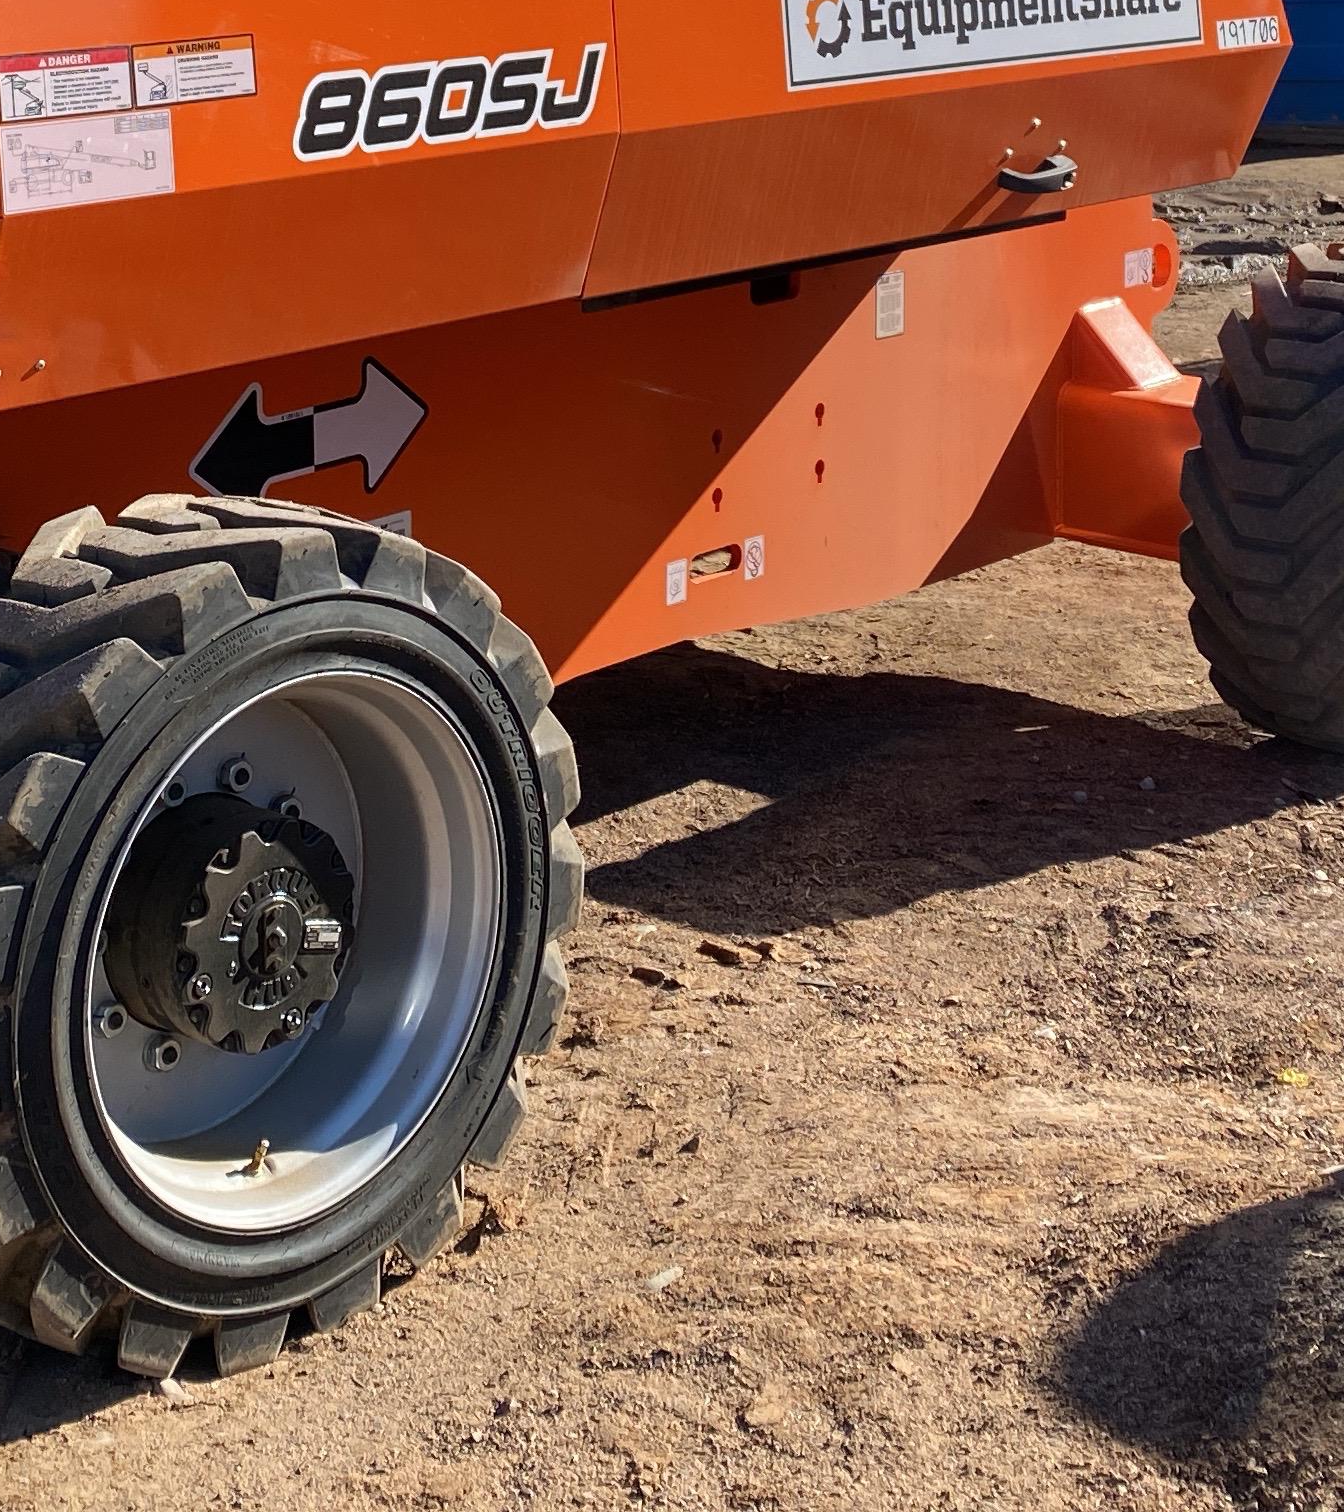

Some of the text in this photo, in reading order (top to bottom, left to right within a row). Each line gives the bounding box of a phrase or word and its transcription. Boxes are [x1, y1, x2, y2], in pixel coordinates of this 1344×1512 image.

[1218, 18, 1279, 47] 191706
[175, 40, 222, 55] WARNING
[47, 53, 92, 67] DANGER
